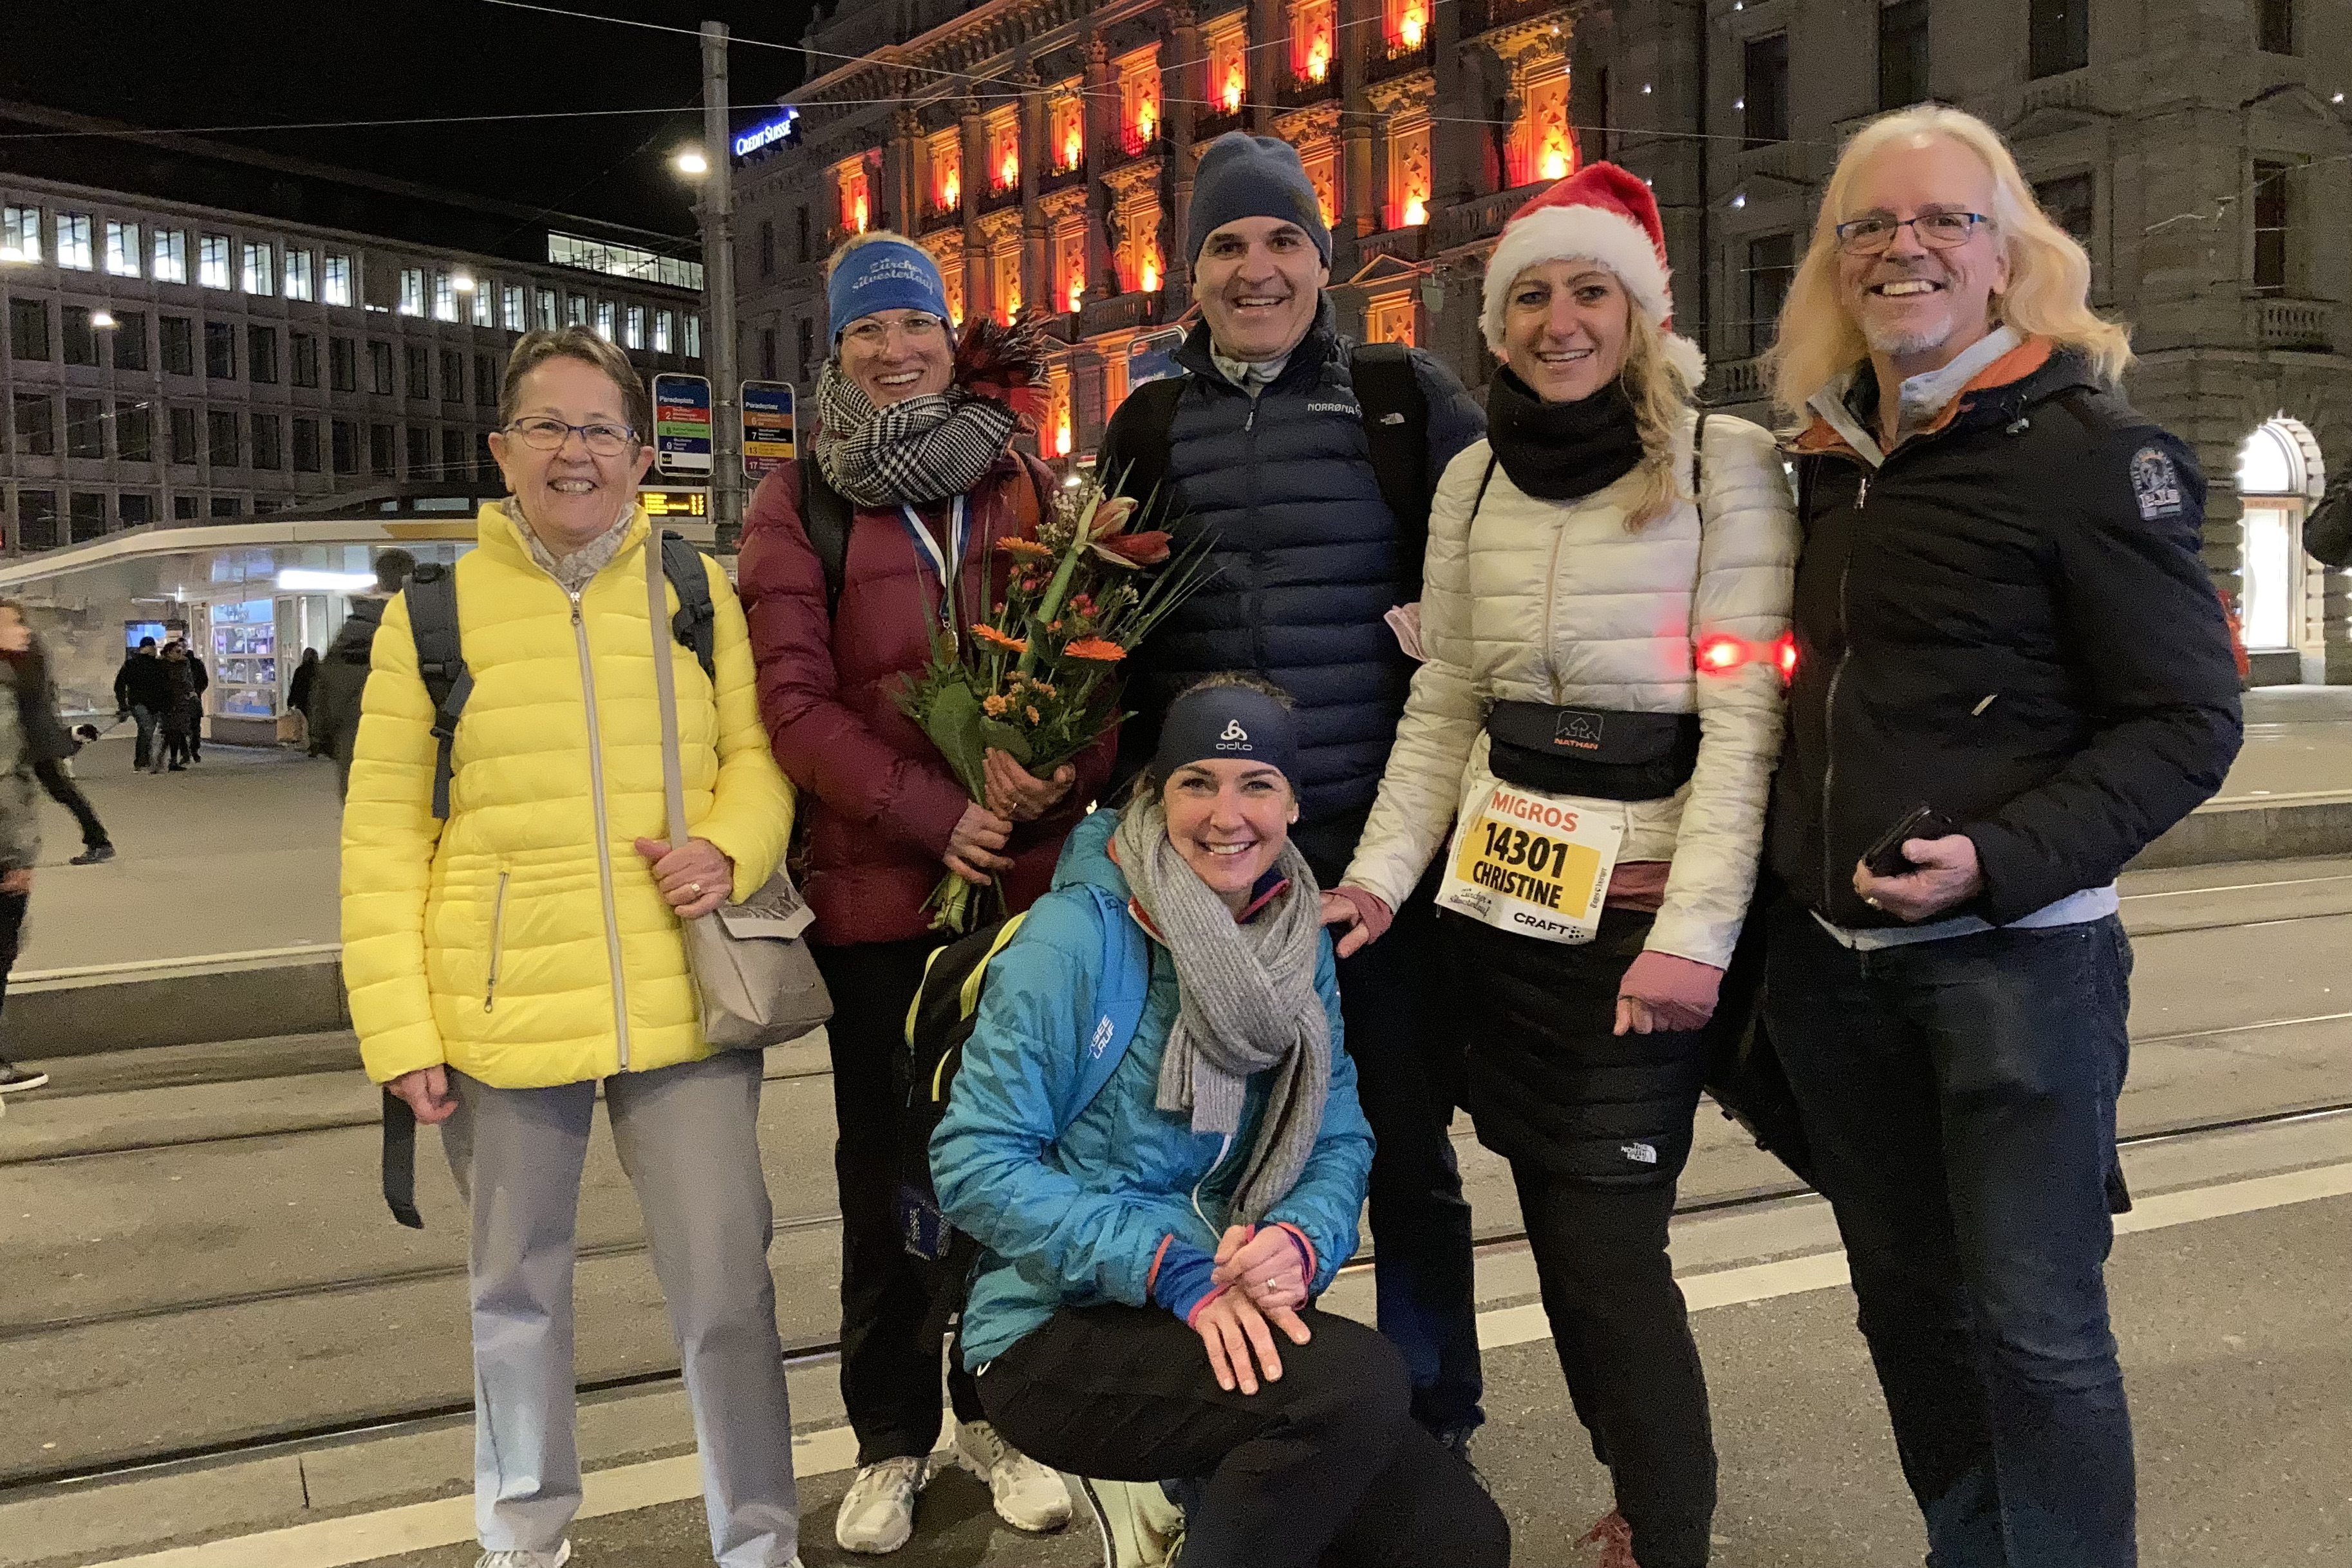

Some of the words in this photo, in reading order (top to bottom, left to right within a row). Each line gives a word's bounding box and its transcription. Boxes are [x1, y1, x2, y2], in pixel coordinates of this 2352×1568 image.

[736, 131, 765, 156] CREDIT
[765, 119, 791, 144] SUISSE
[1307, 403, 1355, 415] NORRØNA
[1553, 738, 1599, 750] NATHAN
[1491, 791, 1579, 832] MIGROS
[1484, 822, 1569, 879] 14301
[1473, 861, 1563, 909] CHRISTINE
[1514, 912, 1569, 935] CRAFT
[1094, 1023, 1114, 1059] LAUF
